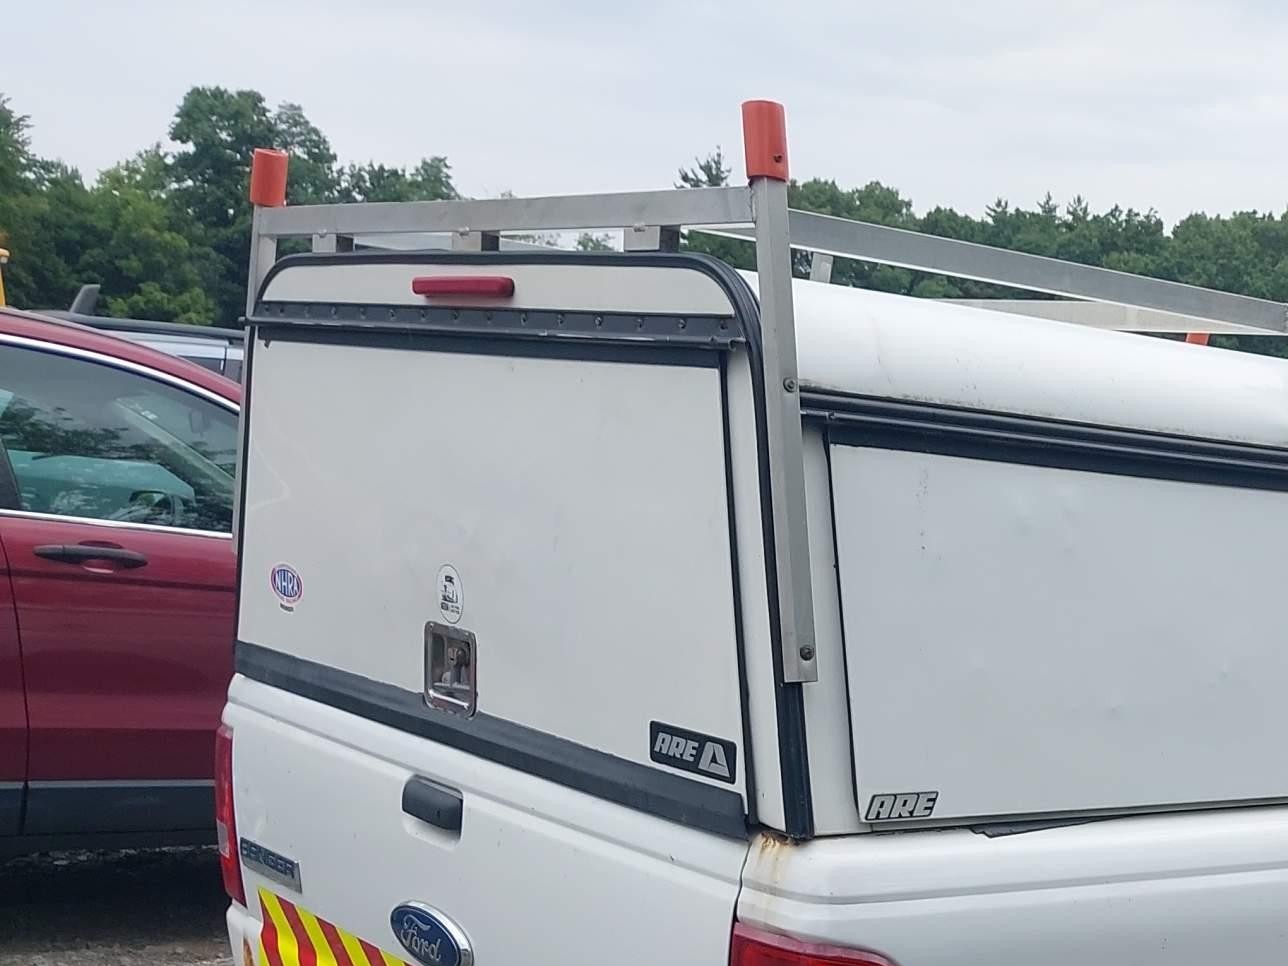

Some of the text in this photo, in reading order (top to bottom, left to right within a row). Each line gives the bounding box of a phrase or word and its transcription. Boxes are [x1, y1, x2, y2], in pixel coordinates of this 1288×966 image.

[275, 568, 300, 598] NHRA
[654, 731, 699, 762] ARE
[865, 791, 939, 820] ARE
[401, 914, 442, 961] Ford
